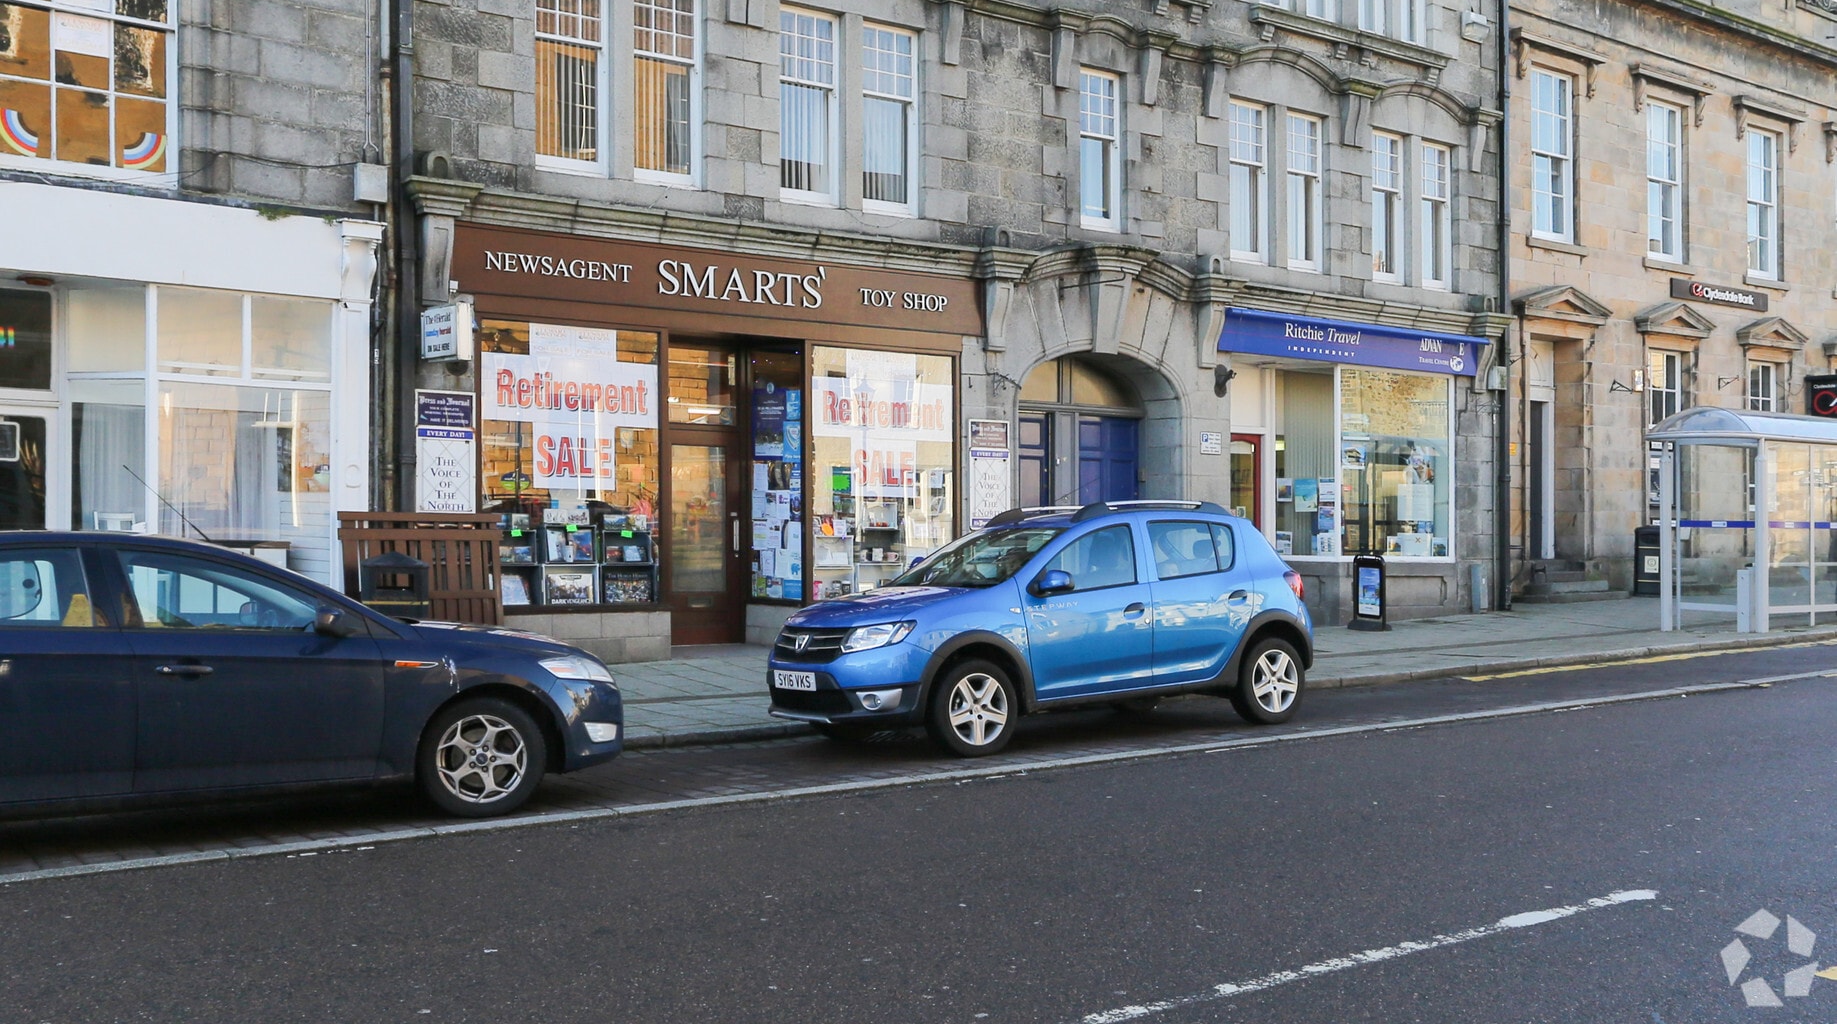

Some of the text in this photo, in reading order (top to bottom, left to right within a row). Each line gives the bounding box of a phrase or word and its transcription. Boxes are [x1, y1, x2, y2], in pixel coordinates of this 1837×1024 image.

[484, 250, 632, 283] NEWSAGENT
[859, 288, 948, 312] TOY SHOP
[1703, 286, 1754, 305] Clydesdale Bank
[1285, 322, 1361, 345] Ritchie Travel
[1288, 345, 1355, 357] INDEPENDENT
[496, 368, 649, 415] Retirement
[823, 390, 945, 430] Retirement
[426, 429, 448, 438] EVERY
[435, 456, 457, 467] THE
[536, 434, 612, 480] SALE
[430, 467, 461, 478] VOICE
[854, 448, 914, 488] SALE
[439, 480, 452, 489] OF
[978, 480, 1000, 490] VOICE
[435, 489, 457, 500] THE
[427, 500, 464, 511] NORTH
[778, 673, 811, 688] SY16 VKS
